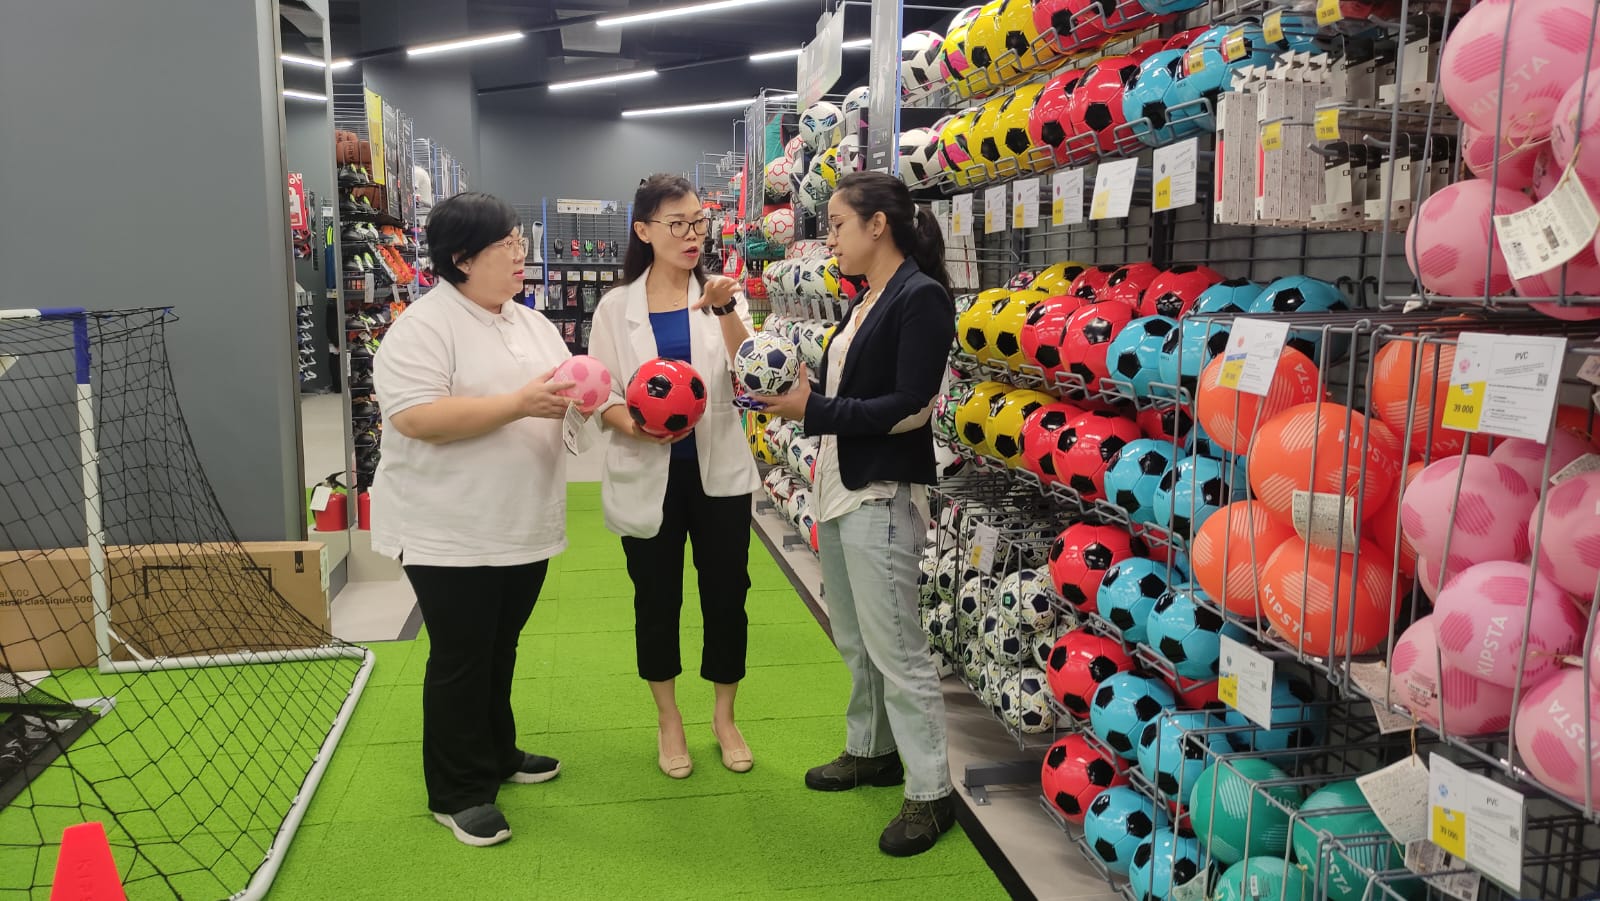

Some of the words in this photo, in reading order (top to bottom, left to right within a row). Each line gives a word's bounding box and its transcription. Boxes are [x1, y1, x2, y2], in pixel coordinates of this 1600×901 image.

[1515, 351, 1529, 360] PVC
[1461, 404, 1474, 414] 000
[73, 595, 94, 604] 500
[1263, 583, 1313, 643] KIPSTA
[1477, 615, 1509, 678] KIPSTA
[1486, 797, 1499, 807] PVC
